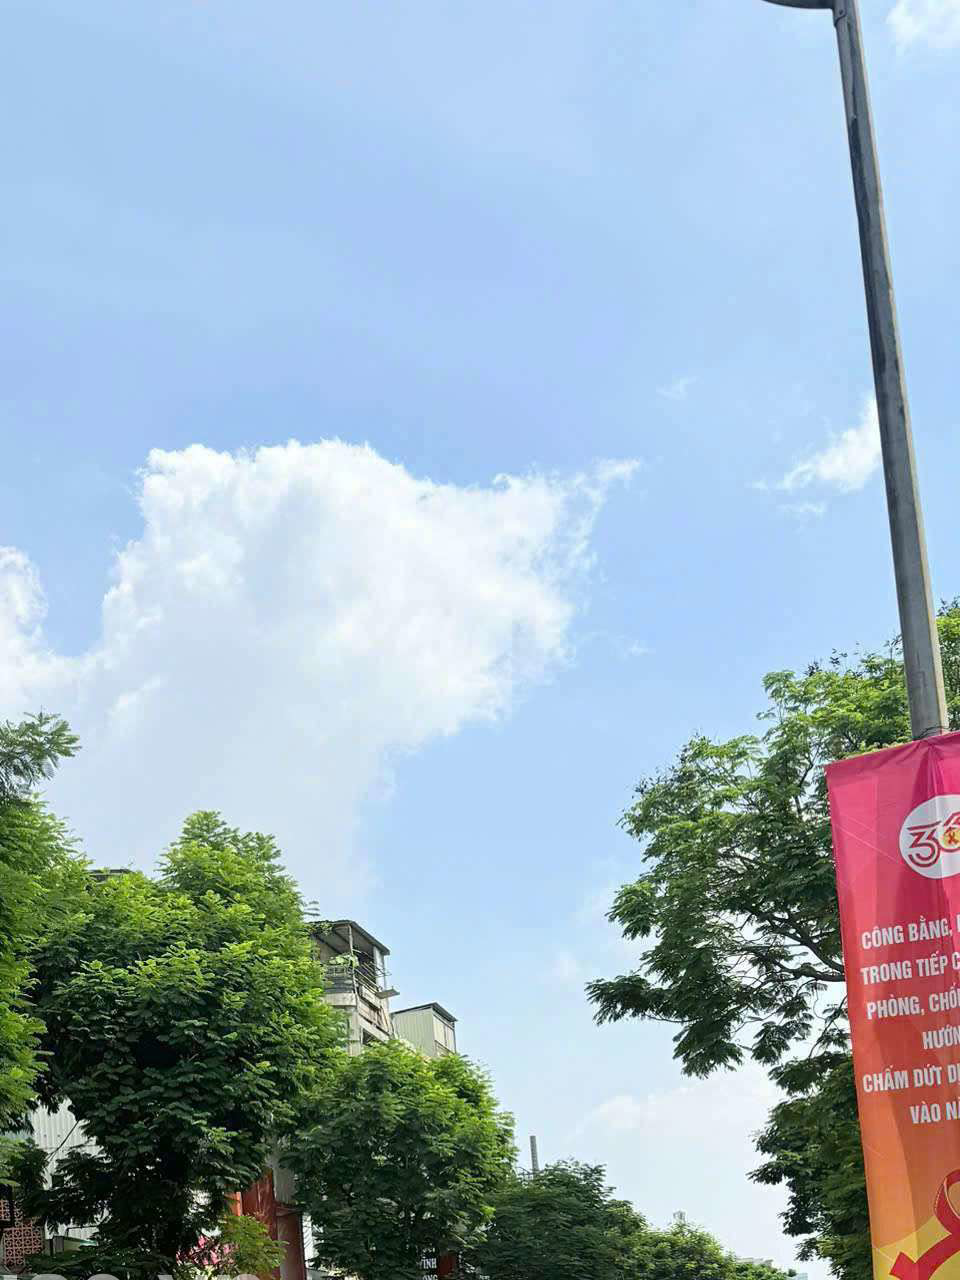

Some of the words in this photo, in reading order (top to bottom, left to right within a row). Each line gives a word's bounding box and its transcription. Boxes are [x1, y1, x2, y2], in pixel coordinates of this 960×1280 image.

[862, 926, 905, 949] CÔNG
[908, 915, 952, 941] BẰNG,
[860, 960, 912, 985] TRONG
[916, 950, 948, 977] TIẾP
[867, 994, 925, 1020] PHÒNG,
[863, 1065, 909, 1092] CHẤM
[913, 1064, 942, 1088] DỨT
[910, 1101, 941, 1124] VÀO
